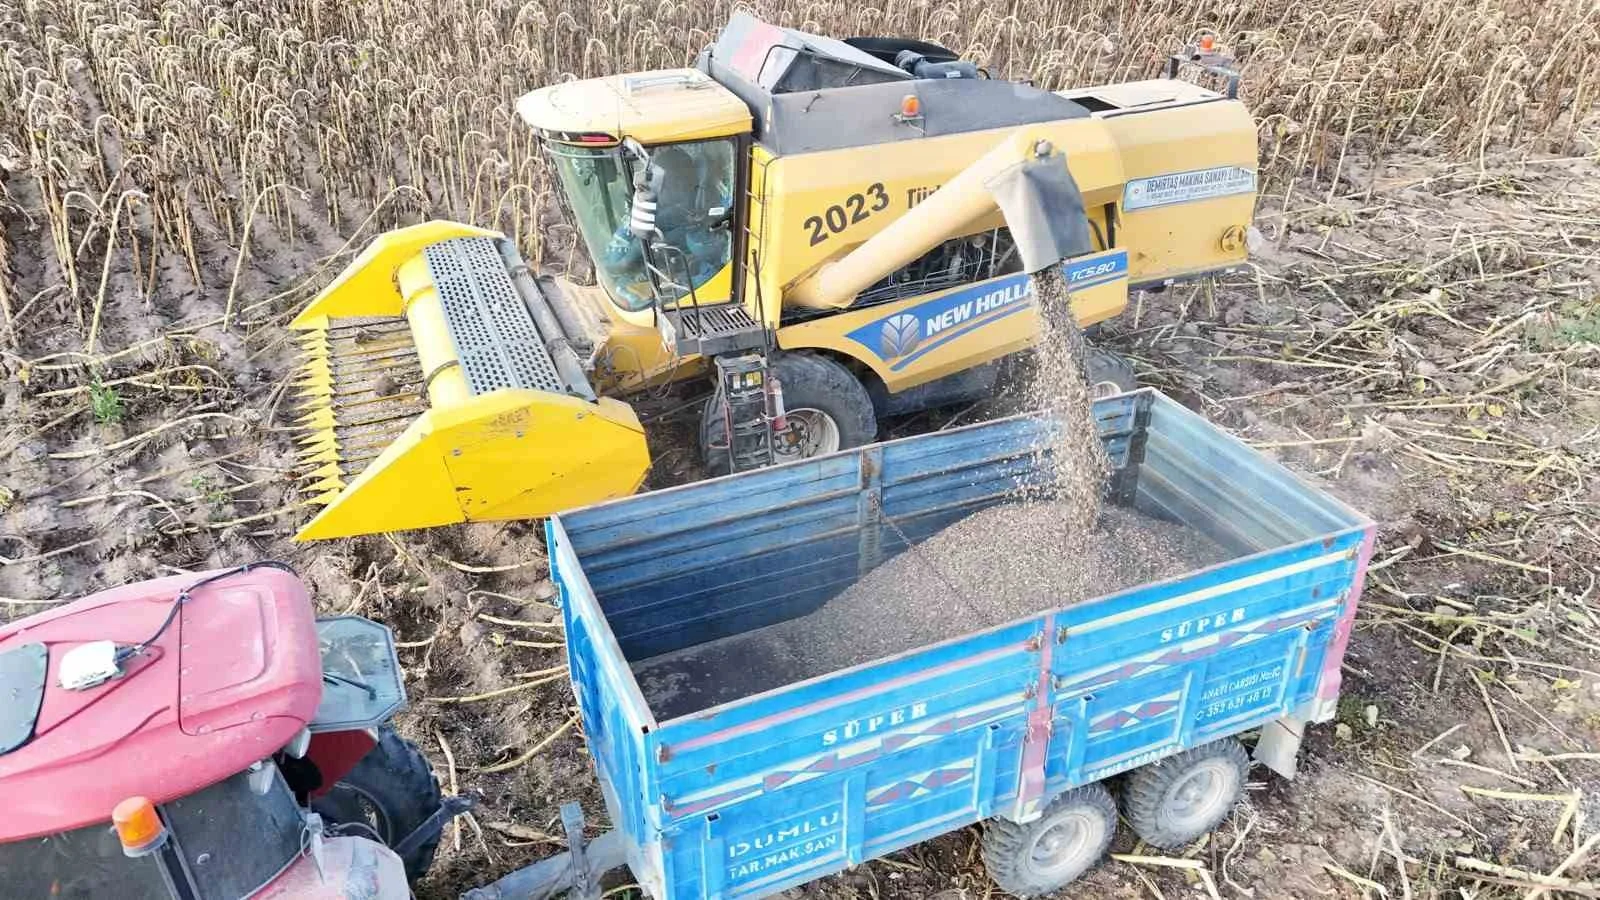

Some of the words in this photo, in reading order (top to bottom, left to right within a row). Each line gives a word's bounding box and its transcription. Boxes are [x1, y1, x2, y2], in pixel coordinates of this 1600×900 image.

[803, 182, 890, 247] 2023
[1071, 261, 1117, 282] TC5.80
[926, 302, 974, 337] NEW
[1160, 607, 1246, 643] SÜPER
[823, 702, 928, 746] SÜPER
[729, 812, 839, 857] DUMLU
[729, 834, 837, 879] TAR.MAK.SAN
